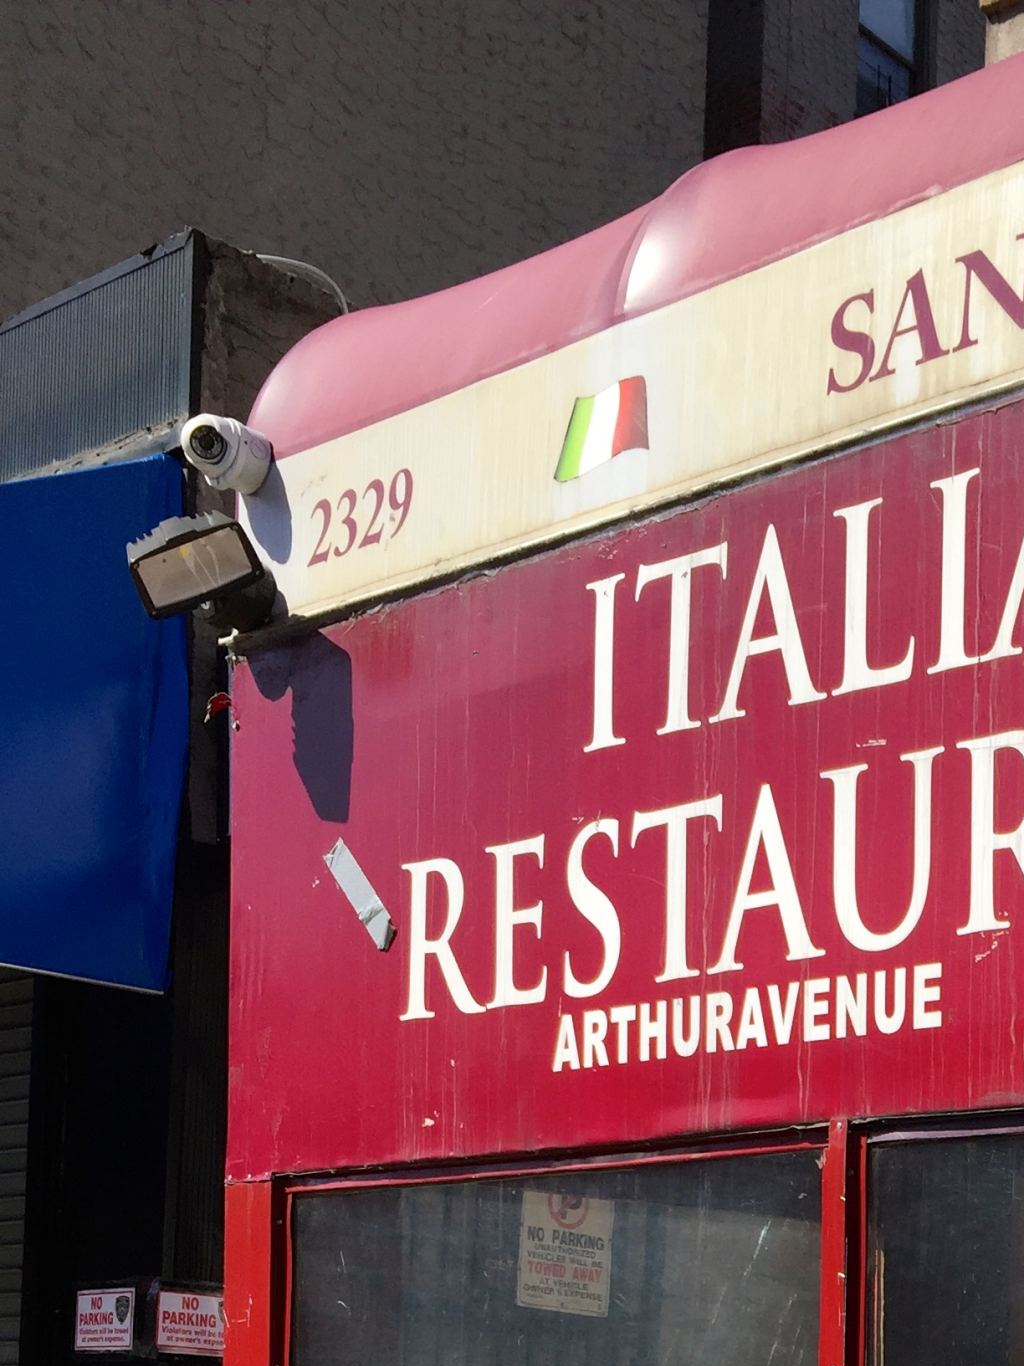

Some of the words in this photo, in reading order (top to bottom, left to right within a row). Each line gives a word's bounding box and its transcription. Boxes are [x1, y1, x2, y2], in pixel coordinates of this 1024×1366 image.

[307, 468, 414, 568] 2329
[527, 1226, 545, 1242] NO
[552, 1229, 605, 1251] PARKING
[527, 1260, 566, 1278] TOWED
[572, 1269, 604, 1283] AWAY
[91, 1297, 103, 1310] NO
[182, 1296, 200, 1311] NO
[79, 1312, 114, 1326] PARKING
[162, 1311, 217, 1328] PARKING
[161, 1325, 192, 1335] Violators
[194, 1329, 207, 1337] will
